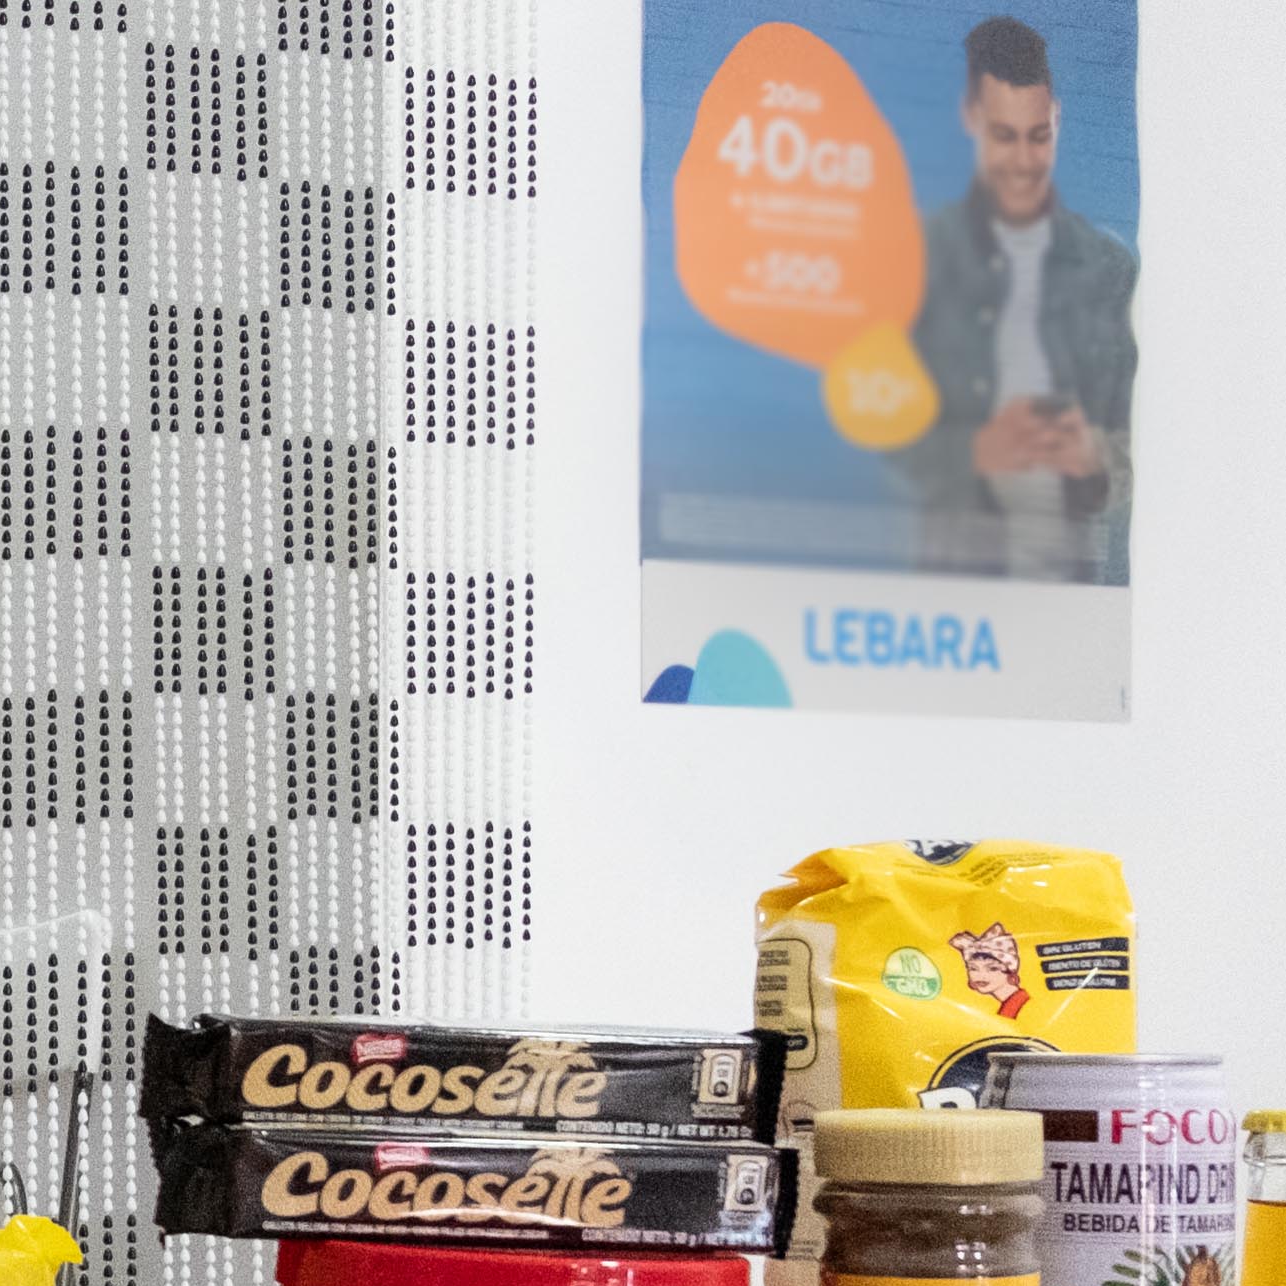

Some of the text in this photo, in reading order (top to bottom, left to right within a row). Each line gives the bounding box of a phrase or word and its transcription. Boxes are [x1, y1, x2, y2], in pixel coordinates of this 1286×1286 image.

[718, 116, 875, 190] 40GB
[804, 609, 1001, 671] LEBARA
[901, 953, 922, 975] NO
[242, 1040, 608, 1118] Cocosette
[1111, 1109, 1228, 1145] FOCO
[262, 1150, 632, 1227] Cocosette
[1050, 1162, 1201, 1205] TAMARIND
[1063, 1213, 1140, 1233] BEBIDA
[1145, 1214, 1171, 1234] DE
